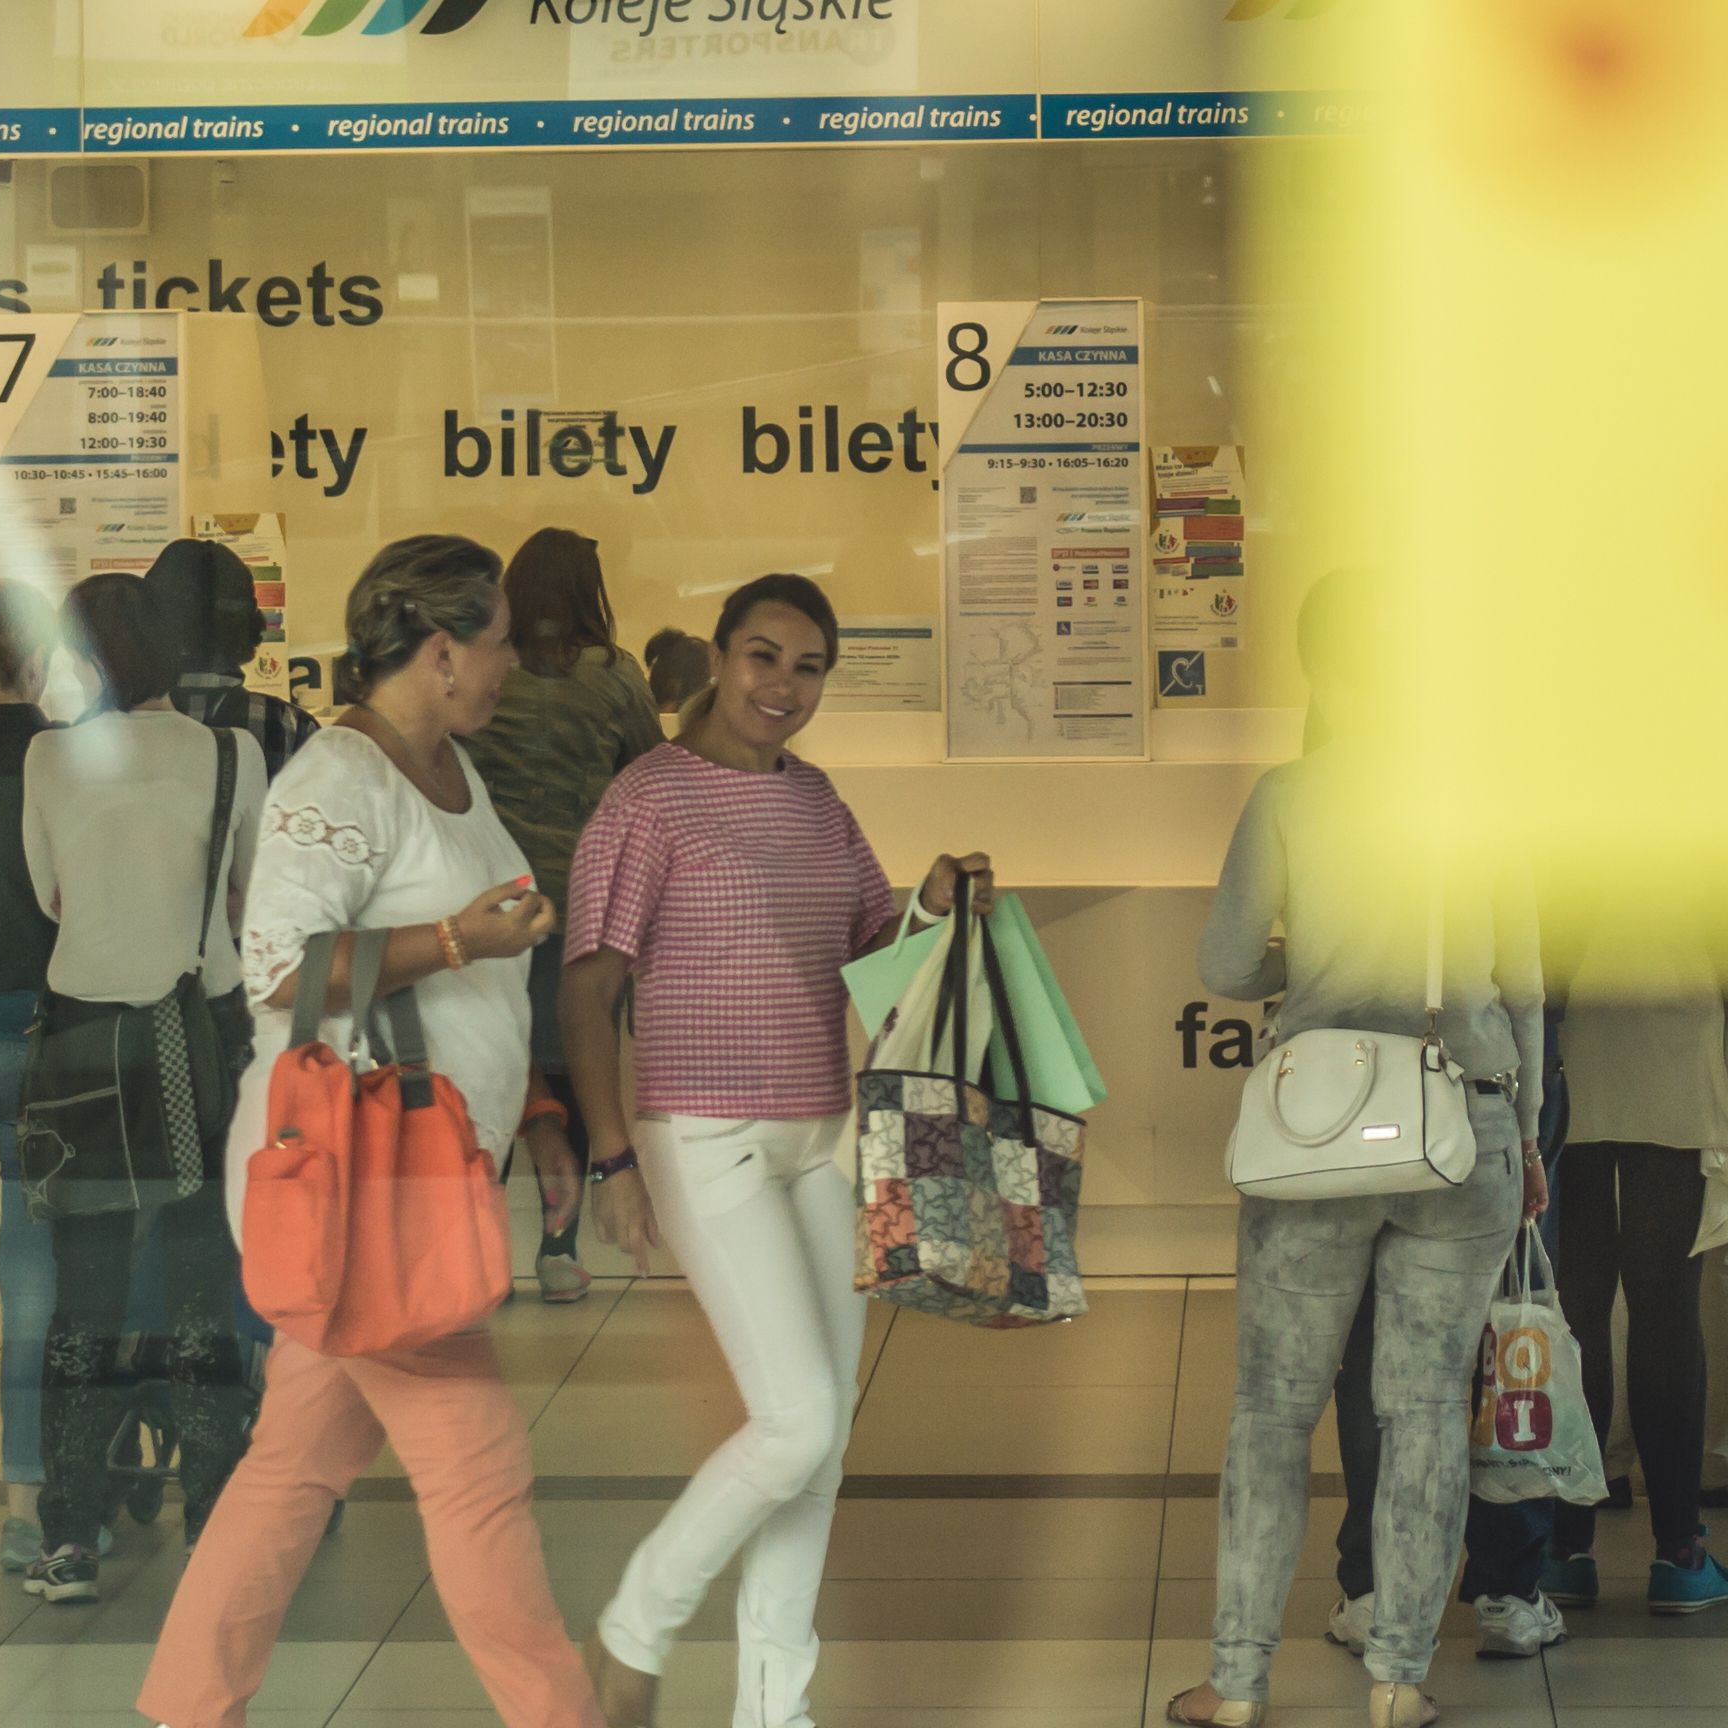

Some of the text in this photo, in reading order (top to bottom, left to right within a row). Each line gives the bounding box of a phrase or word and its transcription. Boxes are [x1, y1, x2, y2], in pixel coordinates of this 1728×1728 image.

[83, 115, 264, 149] regional trains
[327, 112, 509, 147] regional trains
[572, 109, 755, 144] regional trains
[818, 106, 1001, 141] regional trains
[1065, 103, 1249, 137] regional trains
[98, 260, 384, 327] tickets
[79, 361, 166, 373] KASA CZYNNA
[945, 322, 991, 391] 8
[1038, 350, 1127, 362] KASA CZYNNA
[444, 409, 677, 494] bilety
[1175, 1001, 1268, 1069] fa
